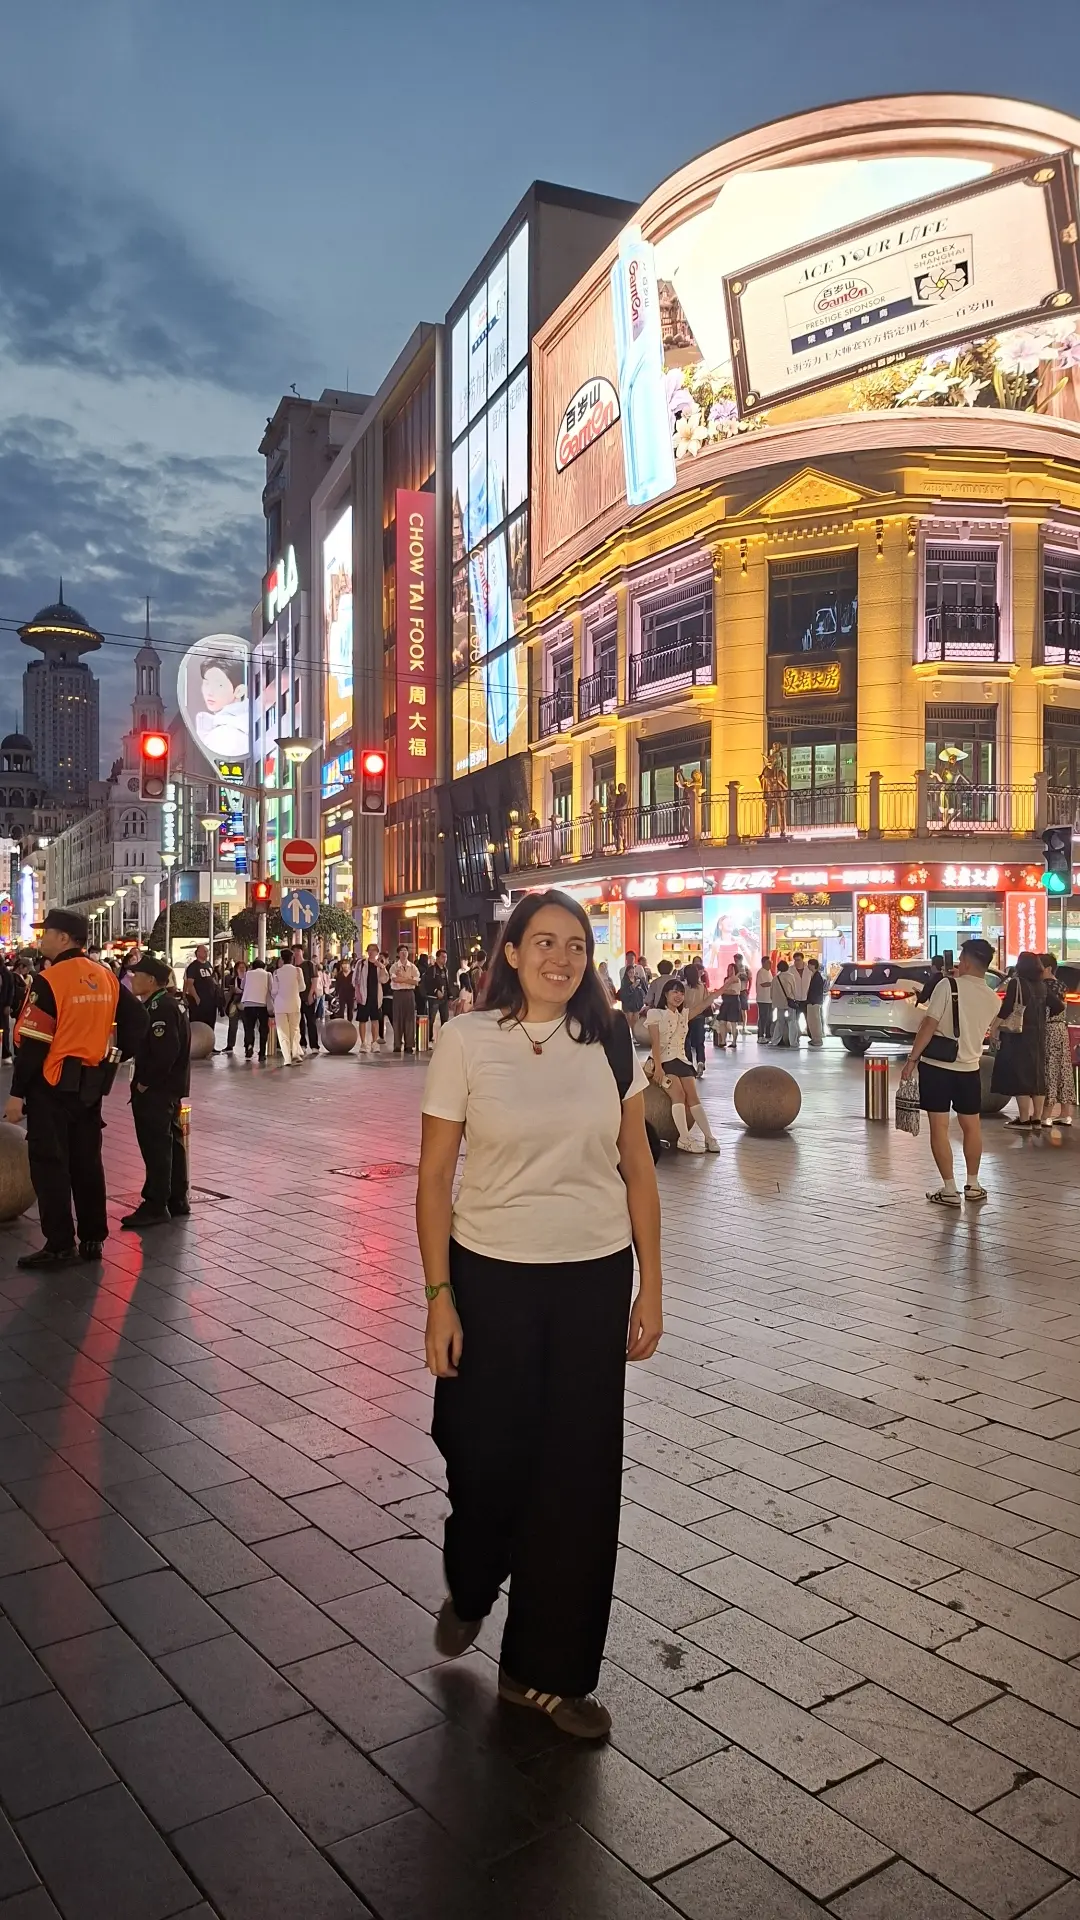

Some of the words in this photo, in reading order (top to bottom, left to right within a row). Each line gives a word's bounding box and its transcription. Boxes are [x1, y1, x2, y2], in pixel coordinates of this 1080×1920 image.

[913, 247, 966, 269] SHANGHAI
[920, 243, 956, 260] ROLEX
[799, 260, 834, 284] ACE
[823, 280, 855, 299] 百岁山
[805, 310, 843, 331] PRESTIGE
[844, 295, 886, 316] SPONSOR
[566, 382, 601, 433] 百岁山
[408, 512, 425, 576] CHOW
[267, 543, 299, 625] FILA
[409, 580, 425, 611] TAI
[409, 618, 425, 672] FOOK
[408, 686, 427, 757] 周大福
[213, 878, 237, 889] LILY
